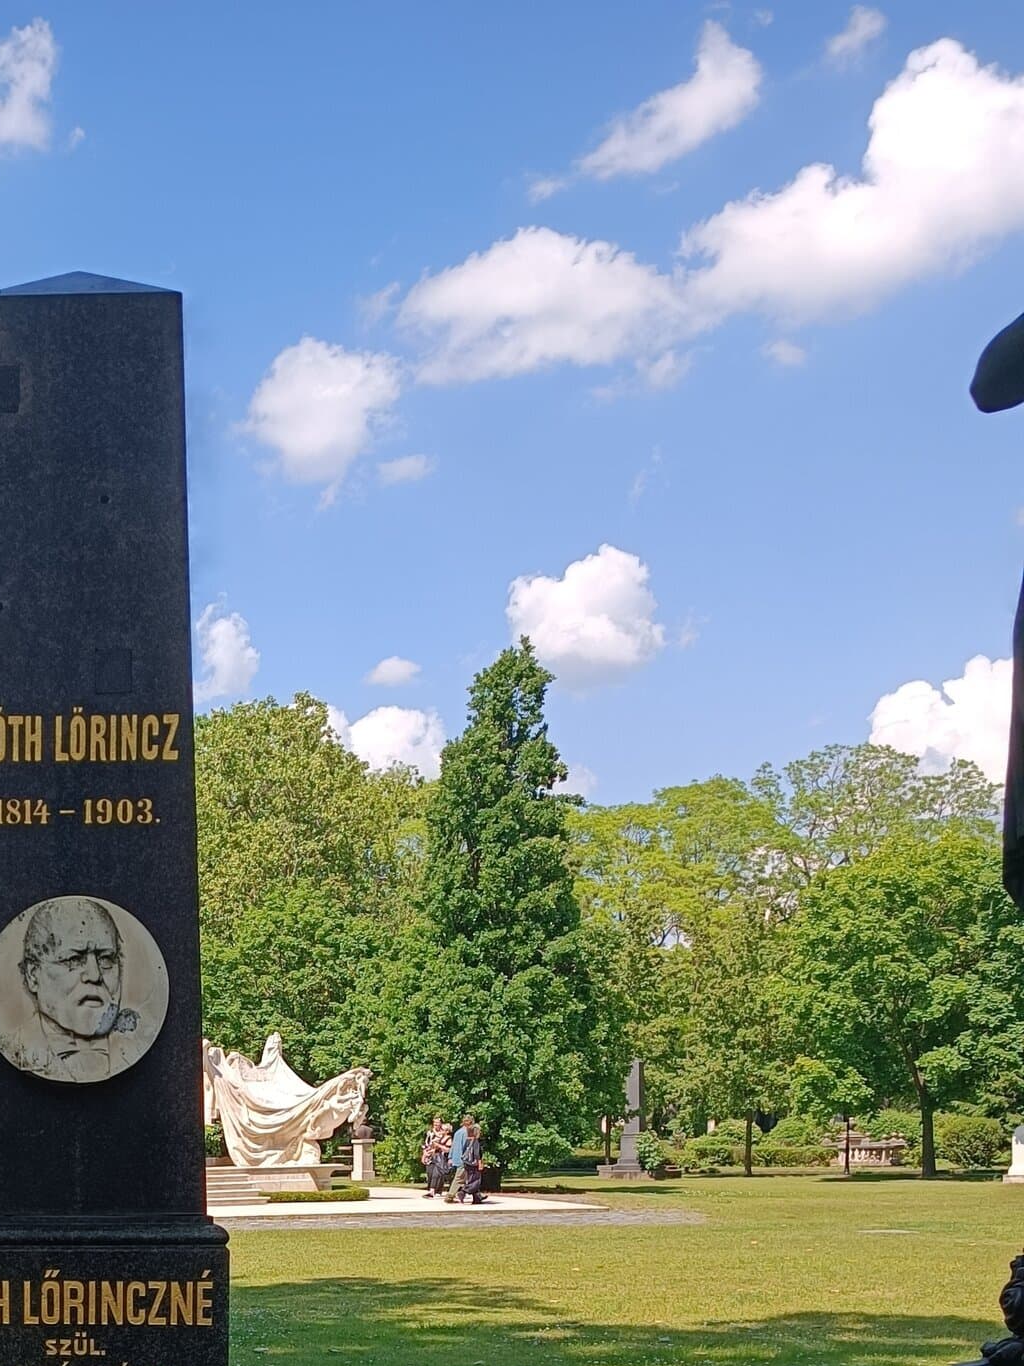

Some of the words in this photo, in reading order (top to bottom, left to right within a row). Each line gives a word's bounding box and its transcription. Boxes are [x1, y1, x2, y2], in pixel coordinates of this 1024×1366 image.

[83, 798, 161, 825] 1903.
[23, 1268, 214, 1327] LŐRINCZNÉ
[45, 1331, 106, 1356] SZÜL.
